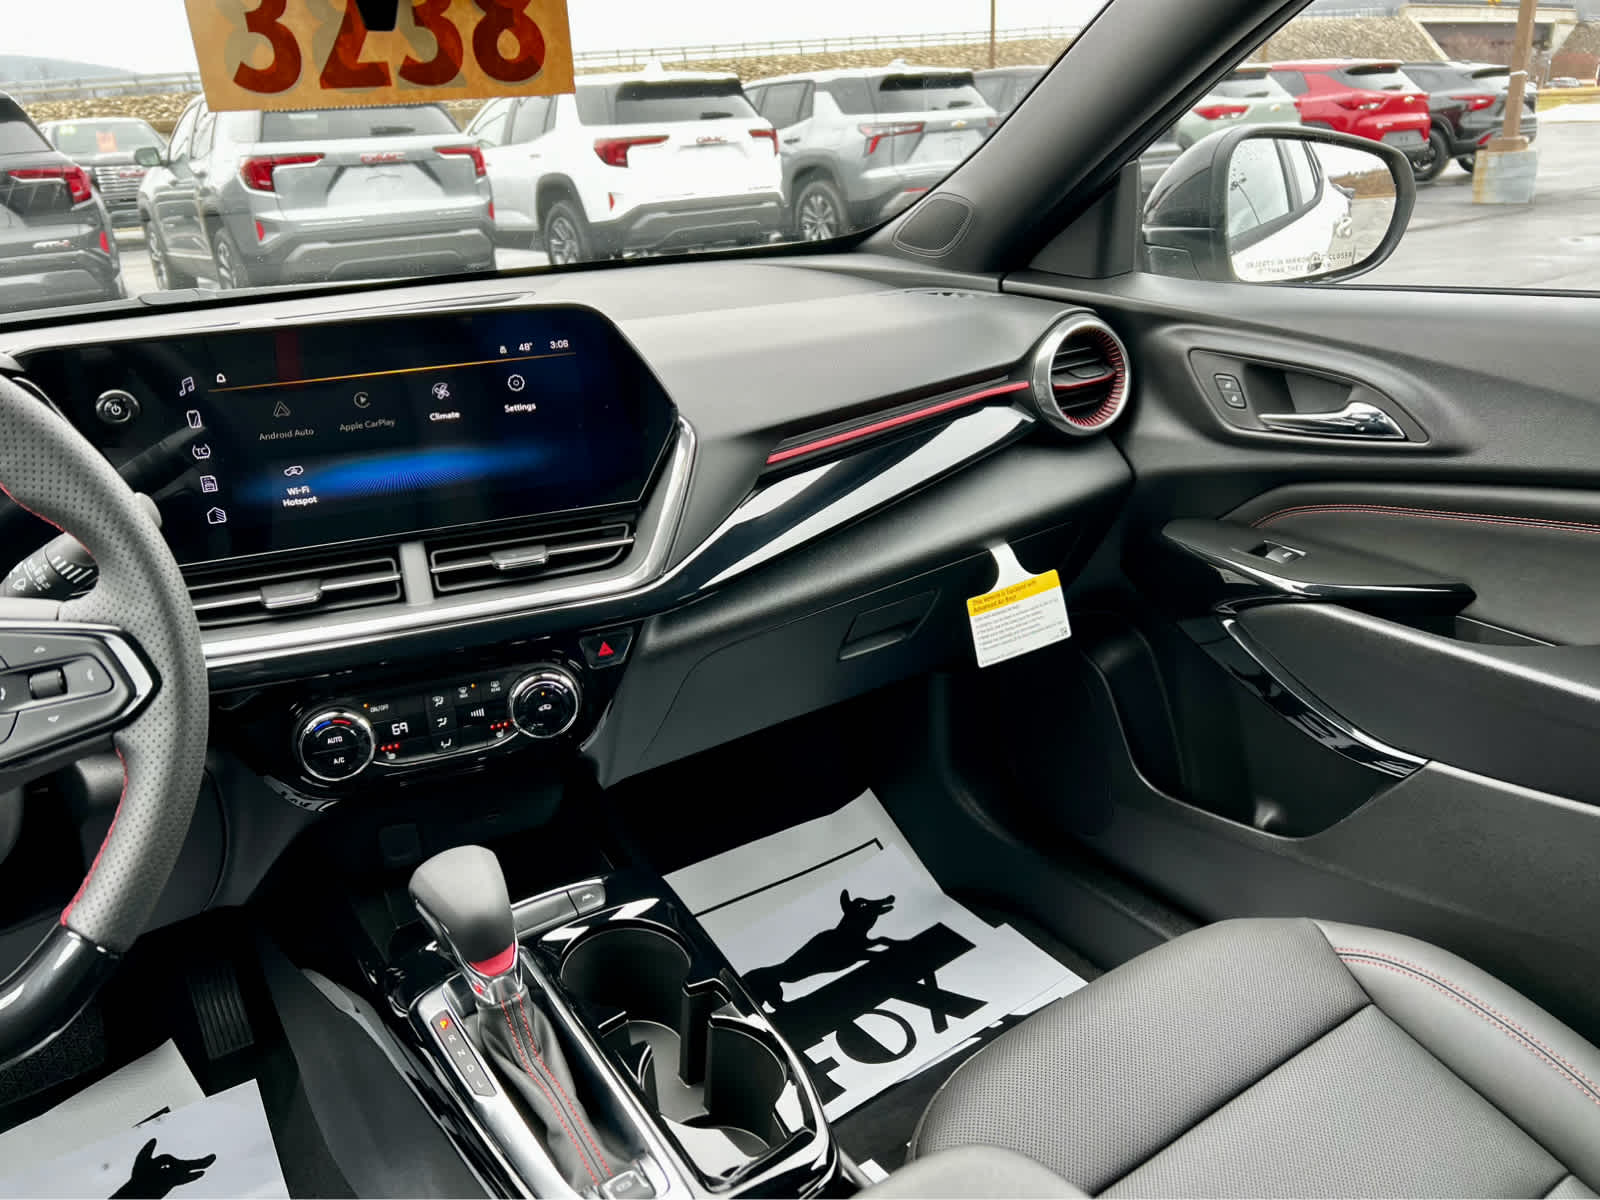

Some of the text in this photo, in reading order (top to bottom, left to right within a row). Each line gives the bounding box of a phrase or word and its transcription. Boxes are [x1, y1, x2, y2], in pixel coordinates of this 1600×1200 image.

[504, 402, 536, 414] Settings
[429, 411, 461, 421] Climate
[339, 418, 396, 432] Apple CarPlay
[259, 427, 315, 441] Android Auto
[286, 485, 311, 496] Wi-Fi
[282, 495, 318, 508] Hotspot
[391, 722, 408, 735] 69
[327, 735, 343, 745] AUTO
[333, 755, 345, 766] A/C
[802, 970, 989, 1106] FOX
